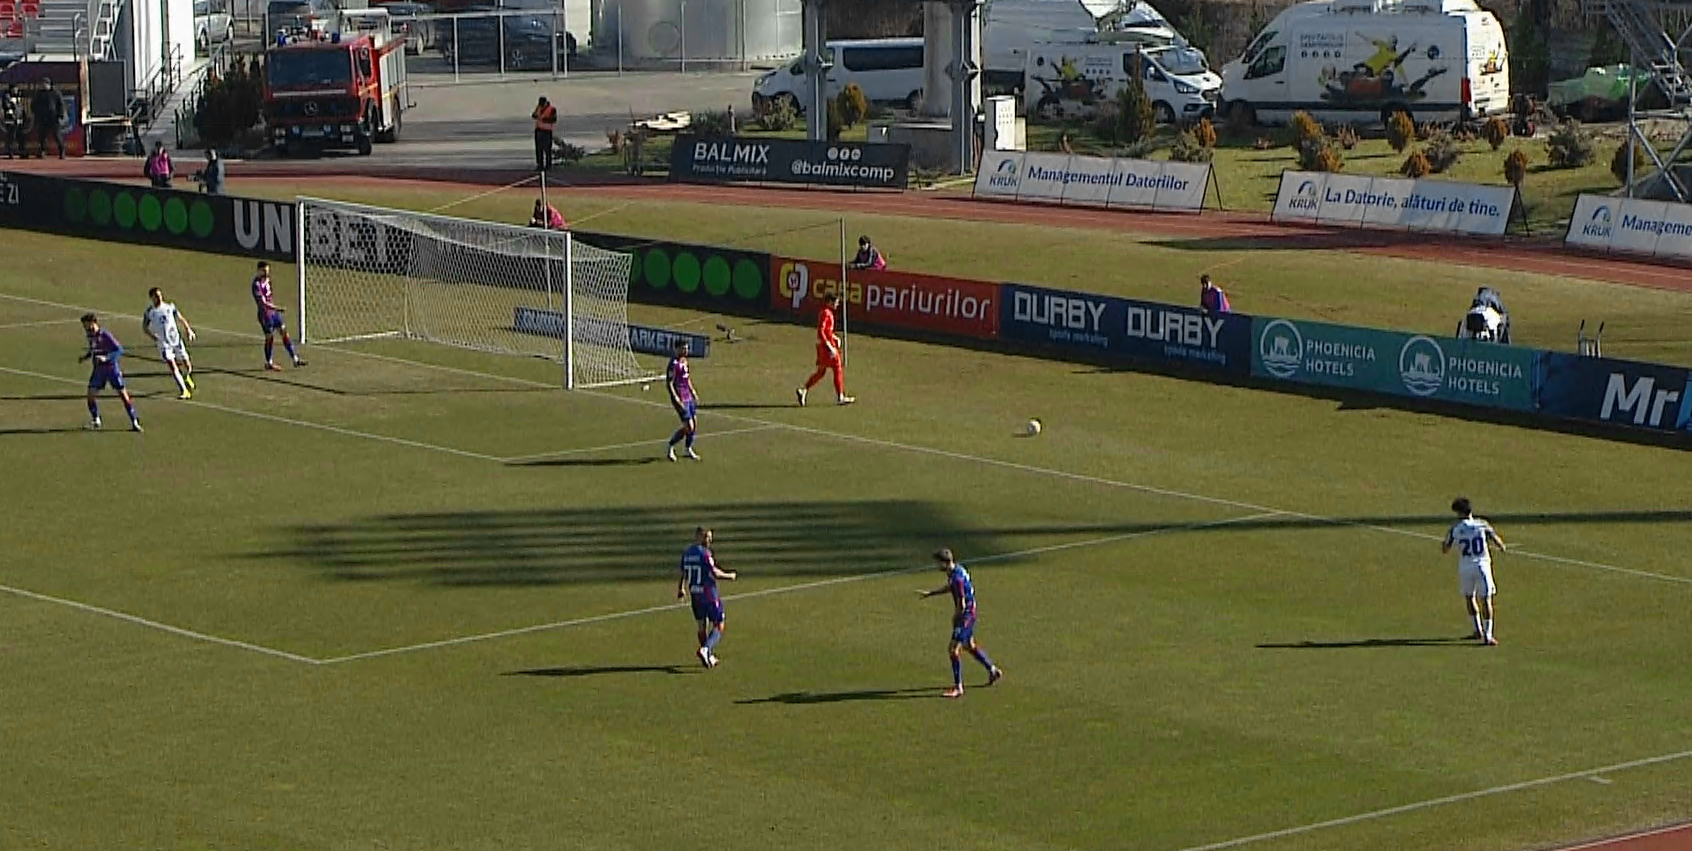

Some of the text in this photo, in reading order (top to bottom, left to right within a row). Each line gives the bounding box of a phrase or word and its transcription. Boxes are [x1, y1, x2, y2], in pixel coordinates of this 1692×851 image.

[694, 142, 770, 163] BALMIX
[791, 159, 895, 182] @balmixcomp
[989, 176, 1018, 187] KRUK
[1028, 165, 1189, 191] Managementul Datoriilor
[1289, 197, 1318, 210] KRUK
[1325, 187, 1341, 203] La
[1345, 189, 1398, 209] Datorie,
[1401, 192, 1445, 213] alături
[1448, 197, 1465, 213] de
[1582, 223, 1612, 237] KRUK
[866, 284, 991, 321] pariurilor
[1014, 290, 1107, 332] DURBY
[1127, 306, 1225, 349] DURBY
[1306, 338, 1376, 361] PHOENICIA
[1305, 358, 1355, 377] HOTELS
[1449, 356, 1523, 379] PHOENICIA
[1448, 375, 1500, 395] HOTELS
[1600, 372, 1692, 428] Mr
[1459, 536, 1484, 557] 20
[683, 565, 702, 585] 77
